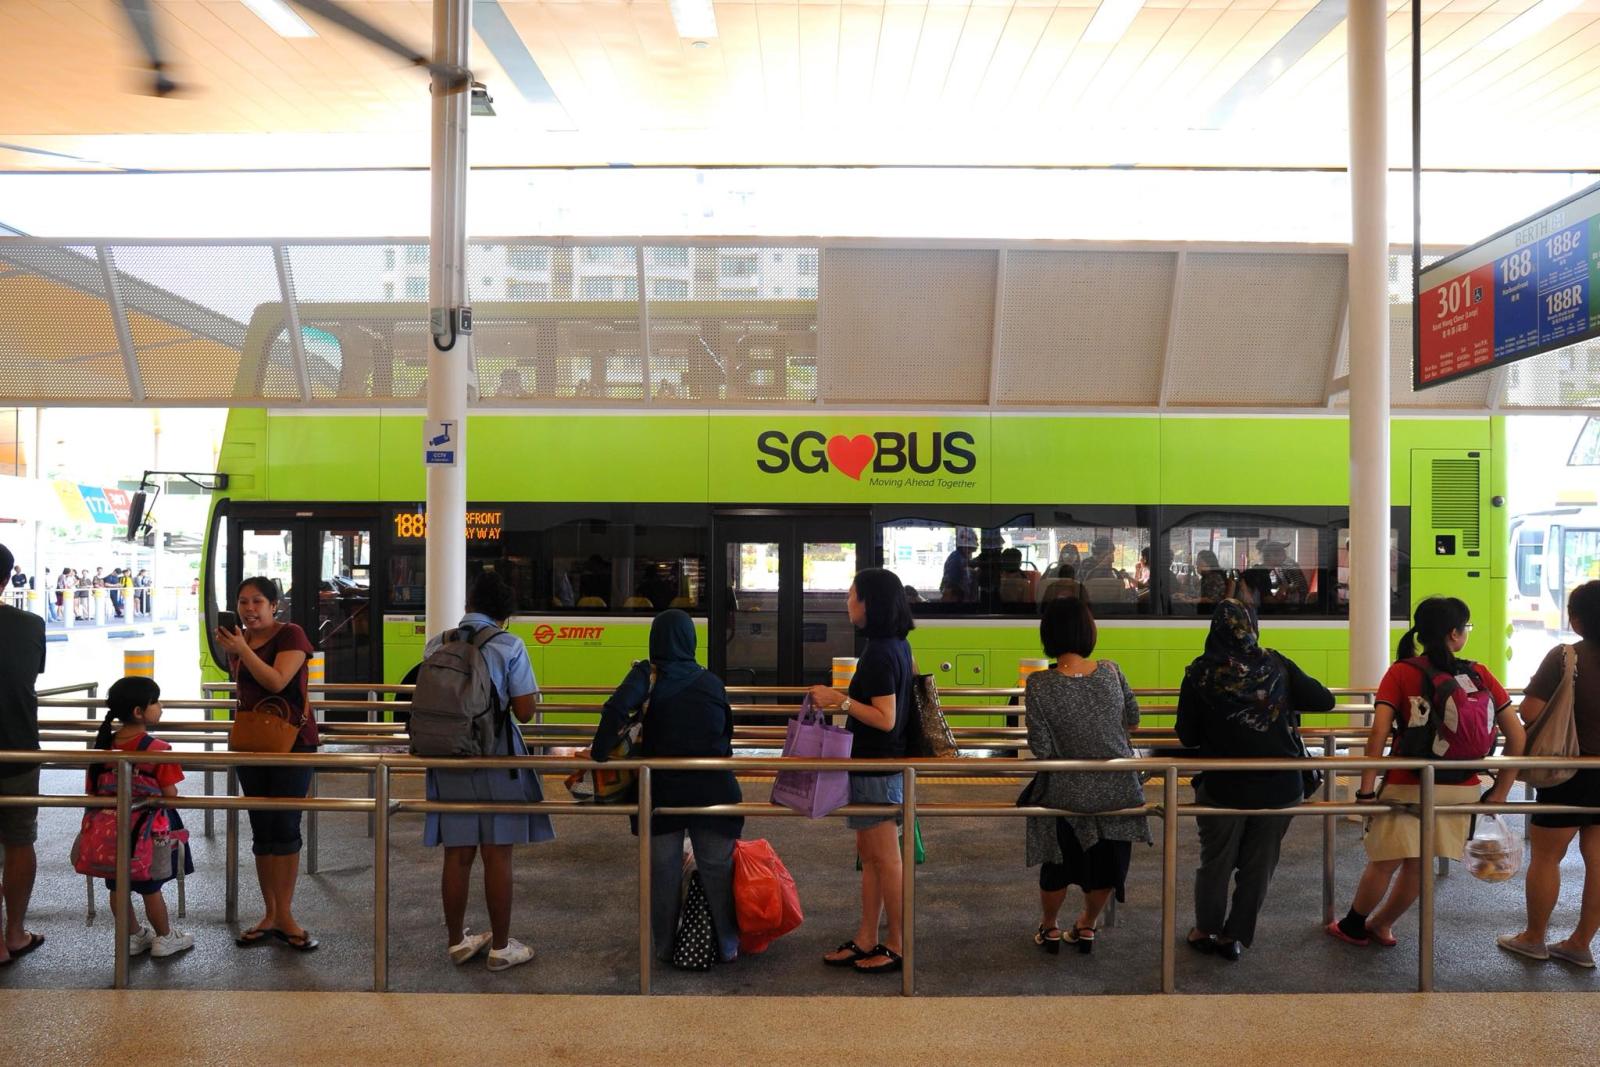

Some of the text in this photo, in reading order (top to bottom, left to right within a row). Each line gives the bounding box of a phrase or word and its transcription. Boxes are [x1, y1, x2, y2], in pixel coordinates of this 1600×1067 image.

[1515, 221, 1548, 247] BERTH
[1545, 230, 1581, 259] 188e
[1501, 249, 1532, 285] 188
[1437, 275, 1471, 319] 301
[1546, 284, 1583, 315] 188R
[757, 430, 977, 475] SG BUS
[869, 477, 977, 489] Moving Ahead Together
[394, 513, 424, 538] 188
[464, 512, 502, 524] RFRONT
[556, 626, 605, 639] SMRT
